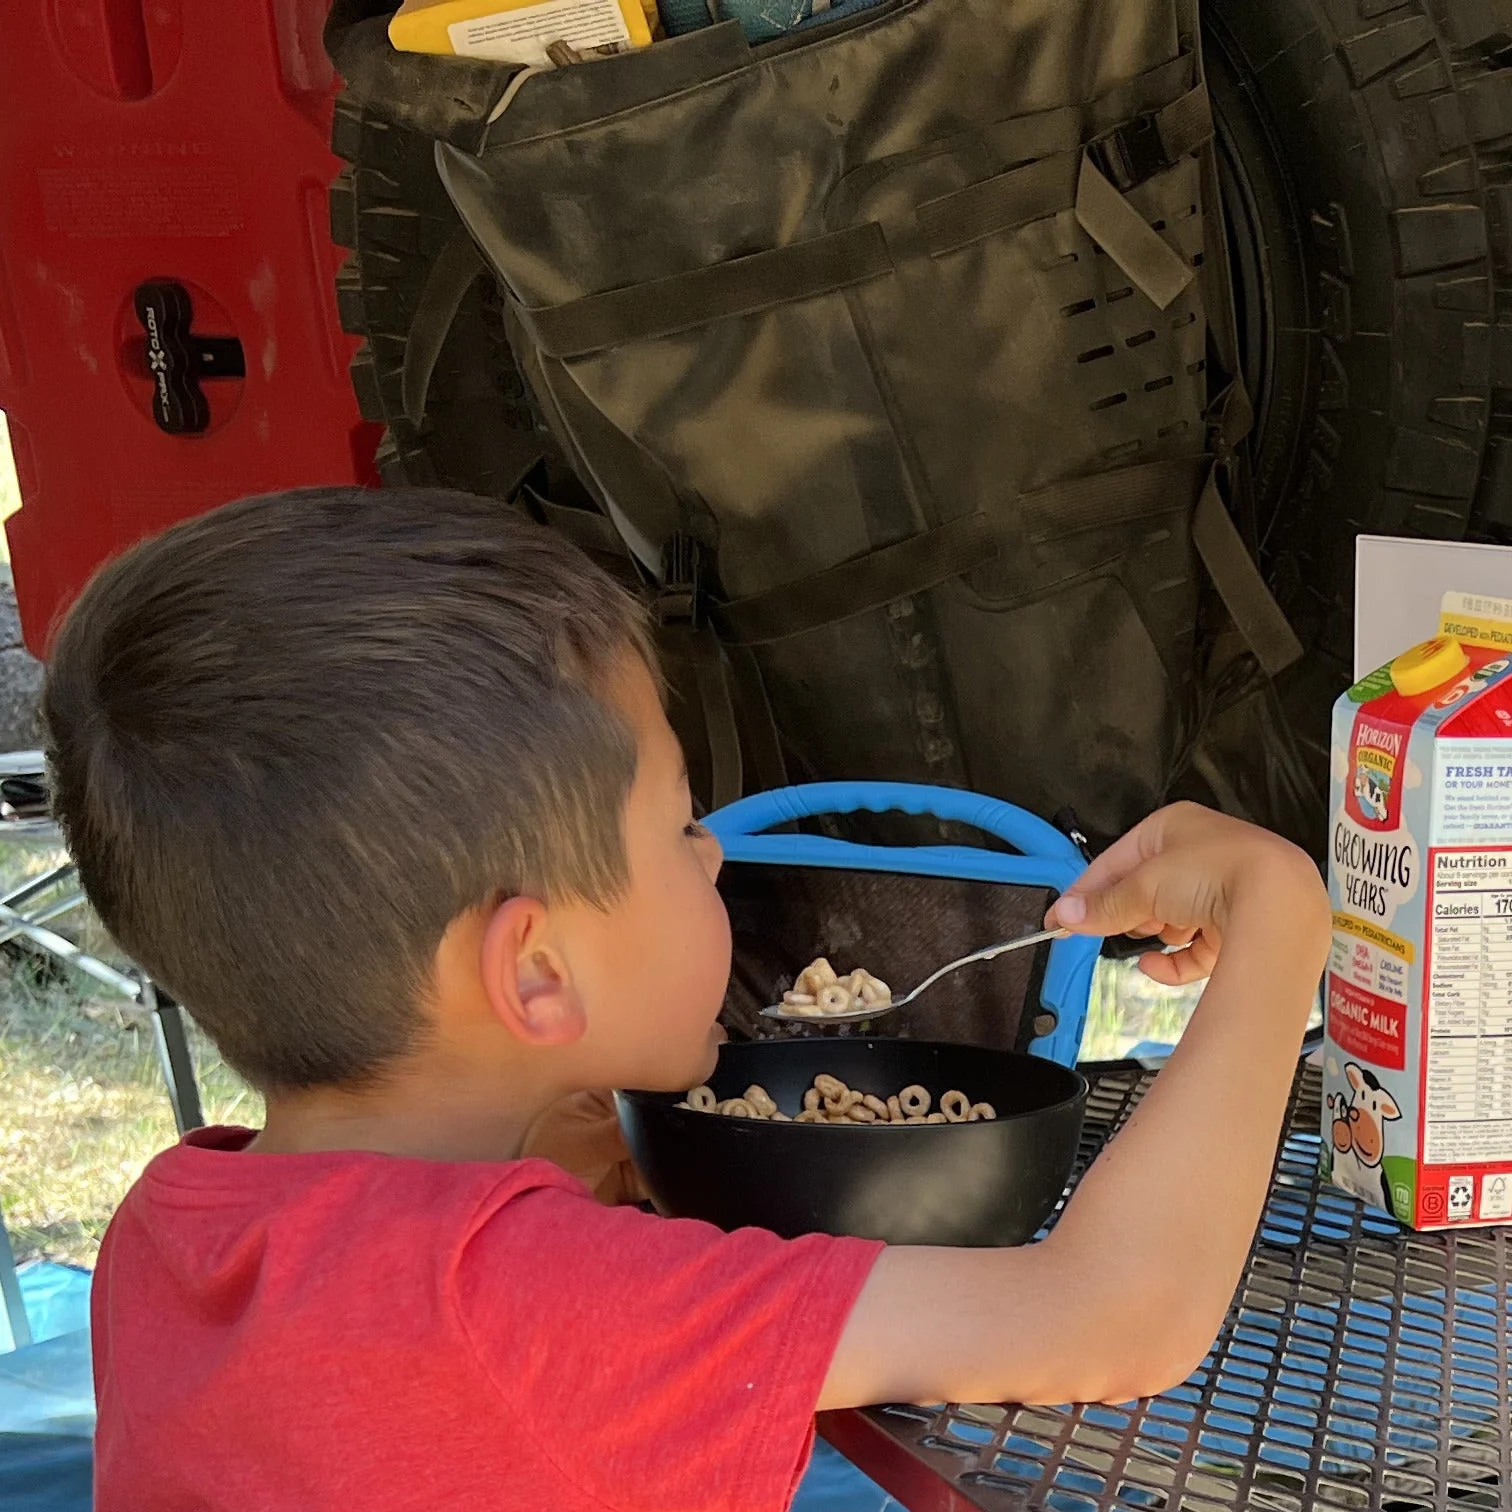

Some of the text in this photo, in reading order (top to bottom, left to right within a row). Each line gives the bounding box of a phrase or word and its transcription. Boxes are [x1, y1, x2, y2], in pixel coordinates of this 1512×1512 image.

[1356, 723, 1402, 757] HORIZON
[1358, 750, 1393, 772] ORGANIC
[1446, 766, 1493, 777] FRESH
[1334, 822, 1412, 887] GROWING
[1437, 855, 1506, 868] Nutrition
[1346, 872, 1386, 917] YEARS
[1436, 880, 1461, 888] Serving
[1435, 904, 1479, 915] Calories
[1331, 990, 1369, 1026] ORGANIC
[1370, 1011, 1399, 1039] MILK
